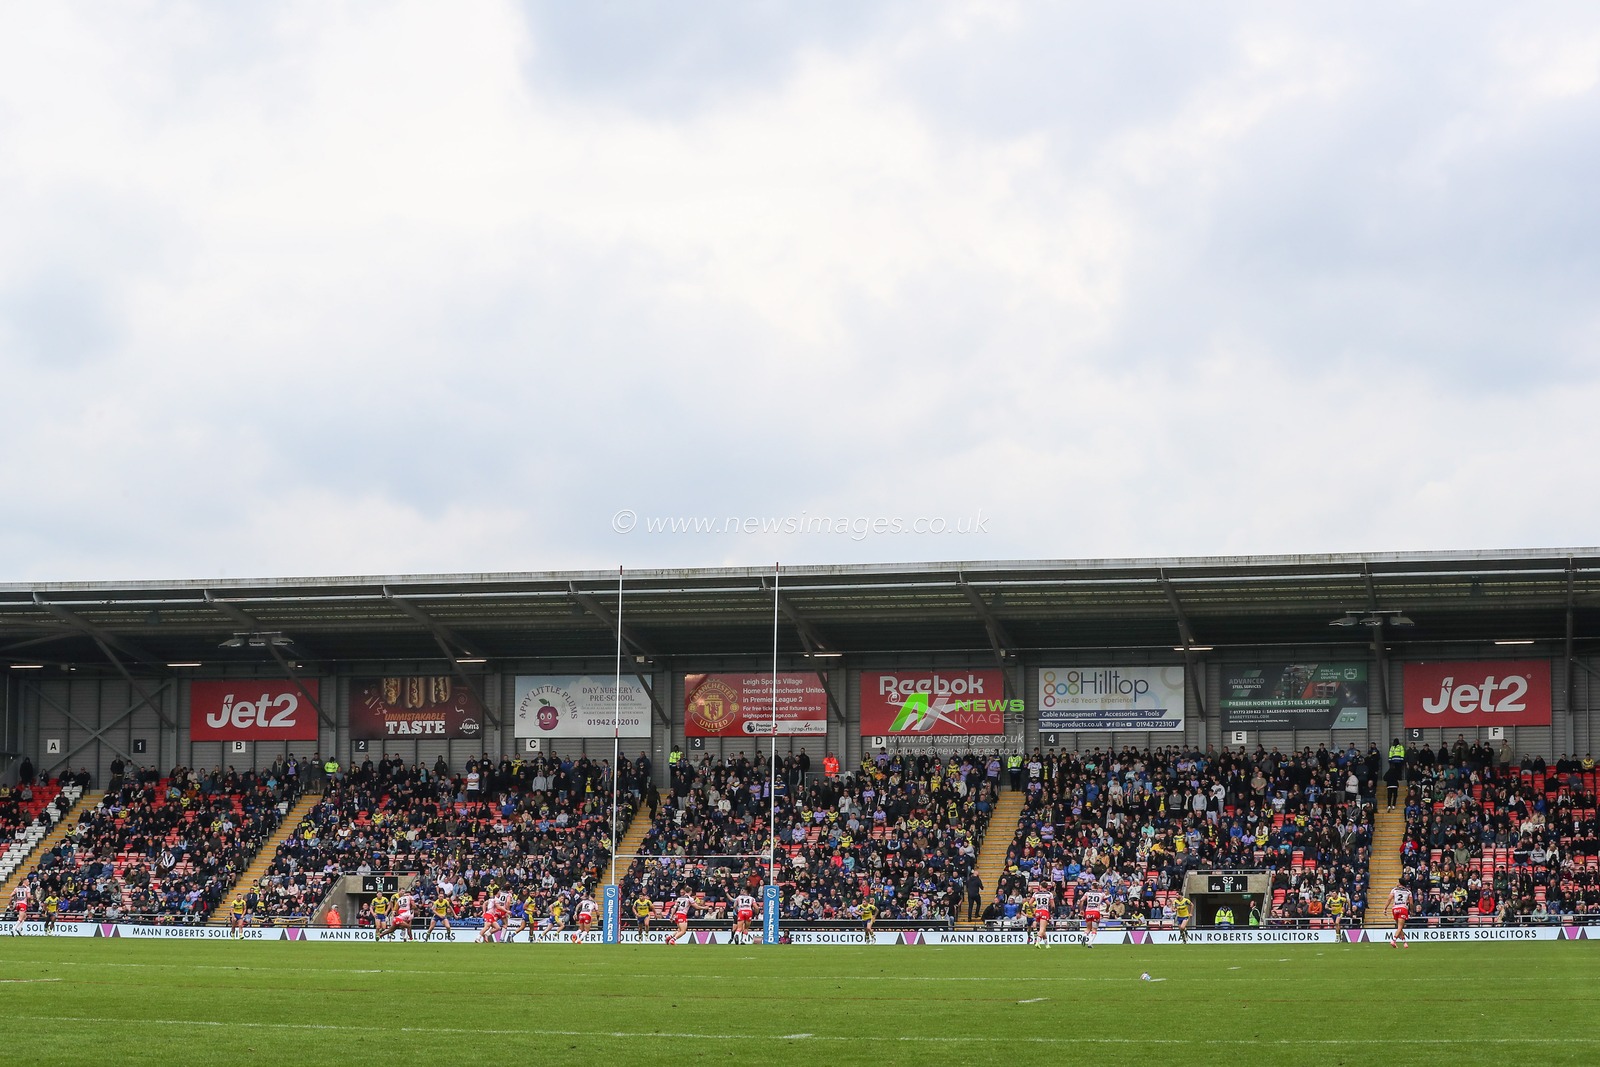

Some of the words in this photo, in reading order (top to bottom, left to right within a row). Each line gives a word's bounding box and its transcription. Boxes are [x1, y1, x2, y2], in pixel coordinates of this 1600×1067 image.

[742, 678, 760, 686] Leigh
[761, 678, 781, 686] Spos
[782, 678, 803, 686] Village
[879, 674, 984, 696] Reebok
[1080, 670, 1149, 703] Hilltop
[582, 686, 599, 694] DAY
[693, 682, 734, 701] MANCHESTER
[519, 695, 532, 719] APPY
[531, 685, 562, 698] LITTLE
[562, 692, 578, 720] PLUMS
[775, 696, 797, 705] League
[1100, 697, 1134, 705] Experience
[384, 712, 446, 720] UNMISTAKABLE
[1059, 711, 1097, 719] Management
[385, 720, 446, 734] TASTE
[699, 719, 728, 729] UNITED
[1041, 721, 1103, 729] hilltop-products.co.uk
[1235, 731, 1243, 740] E
[1412, 729, 1419, 738] 5
[1492, 727, 1499, 736] F
[694, 739, 701, 748] 3
[875, 736, 883, 745] D
[1048, 735, 1055, 743] 4
[50, 743, 57, 751] A
[137, 742, 142, 751] 1
[235, 741, 243, 750] B
[358, 741, 365, 750] 2
[529, 740, 537, 748] C
[1222, 876, 1234, 884] S2
[1087, 895, 1099, 903] 20
[1397, 894, 1404, 902] 2
[0, 924, 23, 932] BER
[26, 924, 79, 933] SOLITORS
[132, 927, 161, 936] MANN
[165, 928, 205, 937] ROBERTS
[208, 929, 263, 938] SOLICIORS
[320, 931, 350, 940] MANN
[354, 932, 396, 940] ROBS
[400, 932, 456, 941] SLICITORS
[564, 934, 603, 942] RERT
[620, 934, 670, 942] OLICIORS
[816, 934, 872, 943] SOLICITO
[940, 934, 974, 943] MANN
[978, 934, 1024, 943] ROBERTS
[1028, 934, 1089, 943] SICITOR
[1207, 932, 1253, 941] ROBERTS
[1257, 932, 1320, 941] SOLICITORS
[1384, 931, 1419, 940] MNN
[1423, 931, 1470, 940] ROBERTS
[1474, 930, 1537, 939] SOLICITORS
